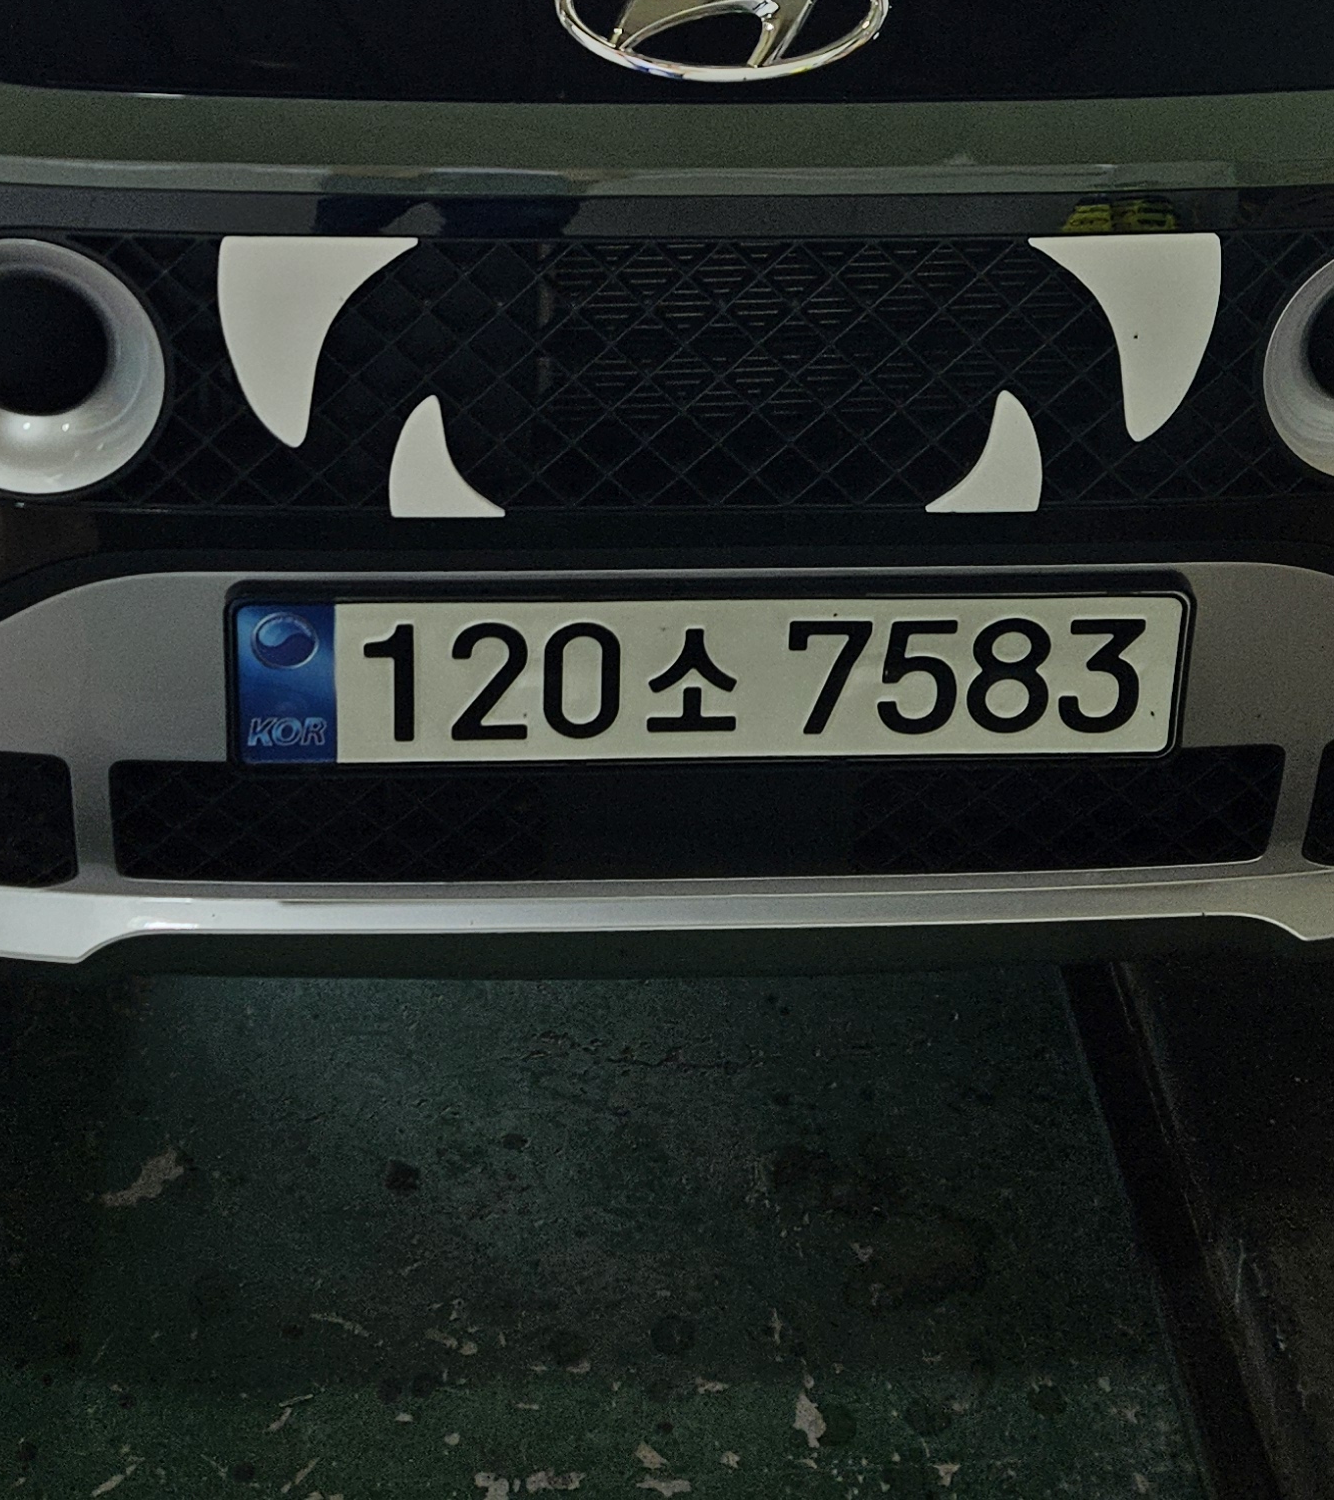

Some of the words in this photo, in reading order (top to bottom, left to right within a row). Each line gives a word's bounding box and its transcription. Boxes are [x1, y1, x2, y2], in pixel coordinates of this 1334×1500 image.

[362, 619, 737, 743] 120소
[787, 616, 1147, 736] 7583
[247, 717, 327, 746] KOR
